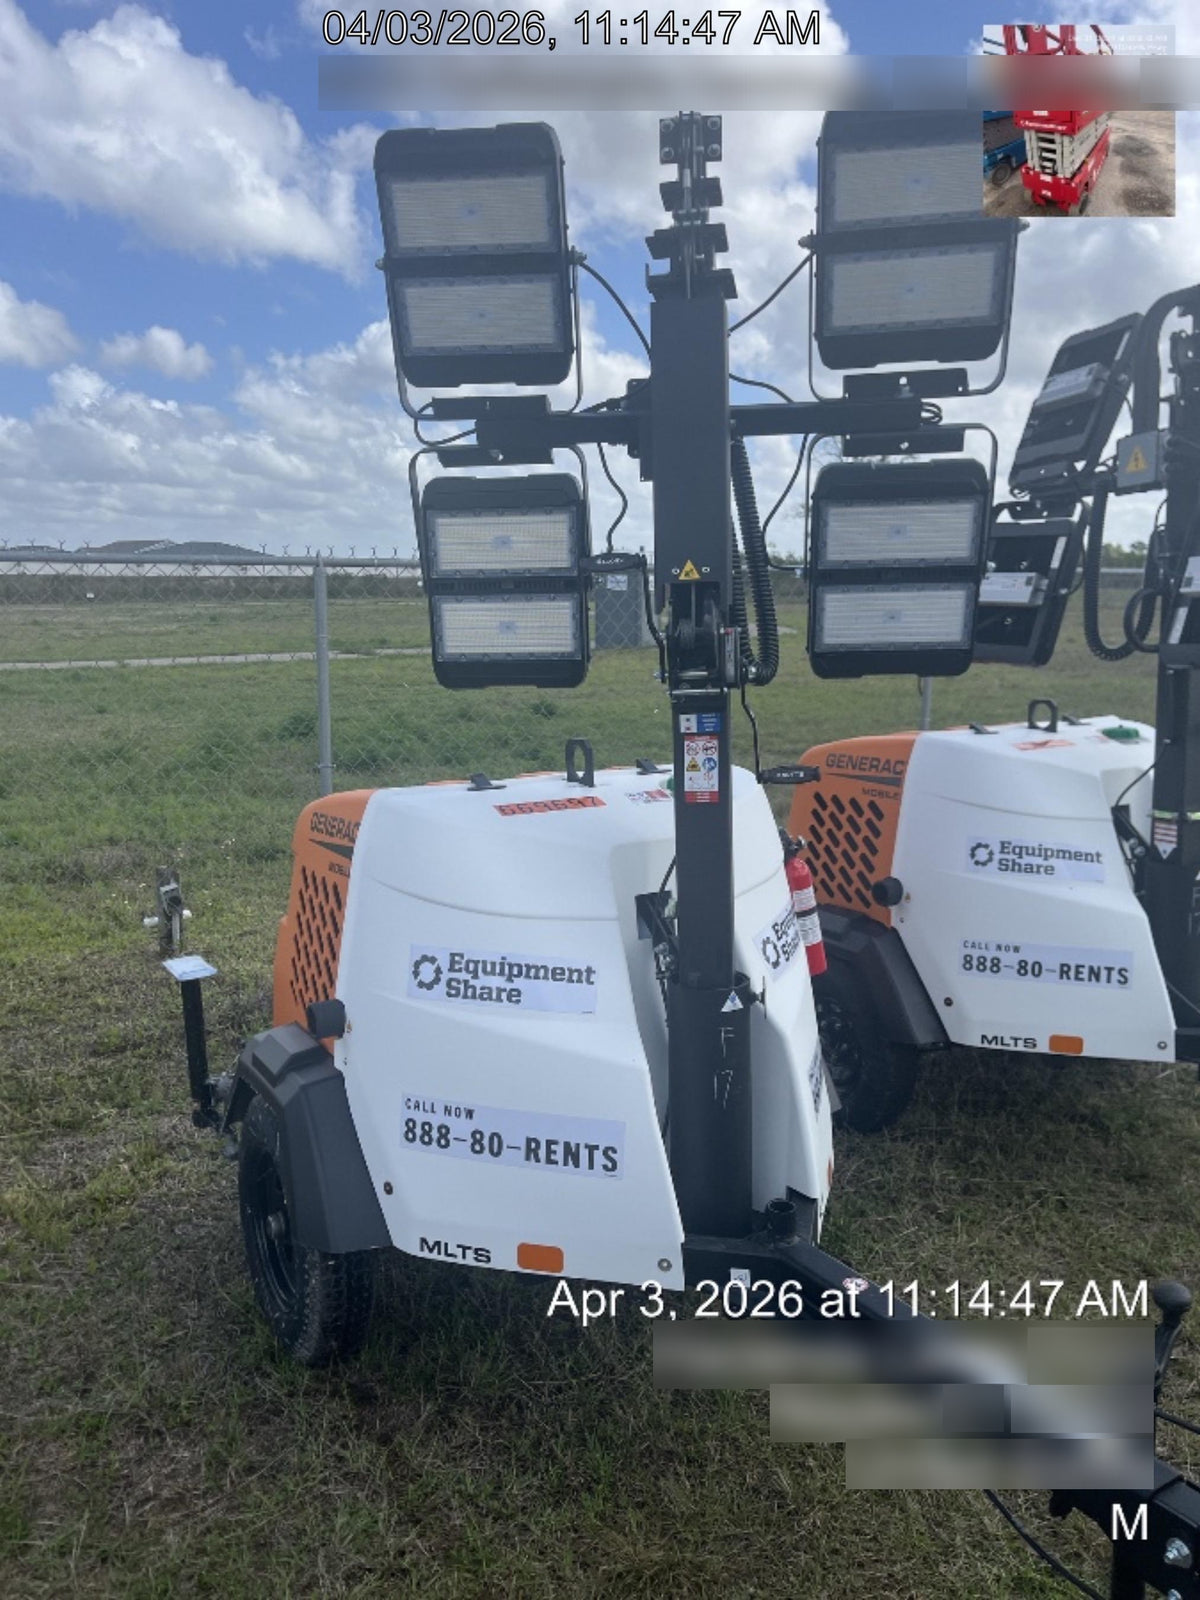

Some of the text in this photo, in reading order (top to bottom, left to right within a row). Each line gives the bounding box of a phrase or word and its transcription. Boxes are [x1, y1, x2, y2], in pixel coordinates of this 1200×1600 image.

[825, 753, 906, 776] GENERAC
[998, 841, 1103, 864] Equipment
[997, 858, 1055, 876] Share
[963, 940, 1021, 954] CALL NOW
[448, 952, 596, 986] Equipment
[962, 953, 1129, 986] 888-80-RENTS
[445, 977, 522, 1005] Share
[981, 1034, 1037, 1049] MLTS
[404, 1097, 475, 1120] CALL NOW
[403, 1117, 618, 1172] 888-80-RENTS
[419, 1236, 491, 1264] MLTS
